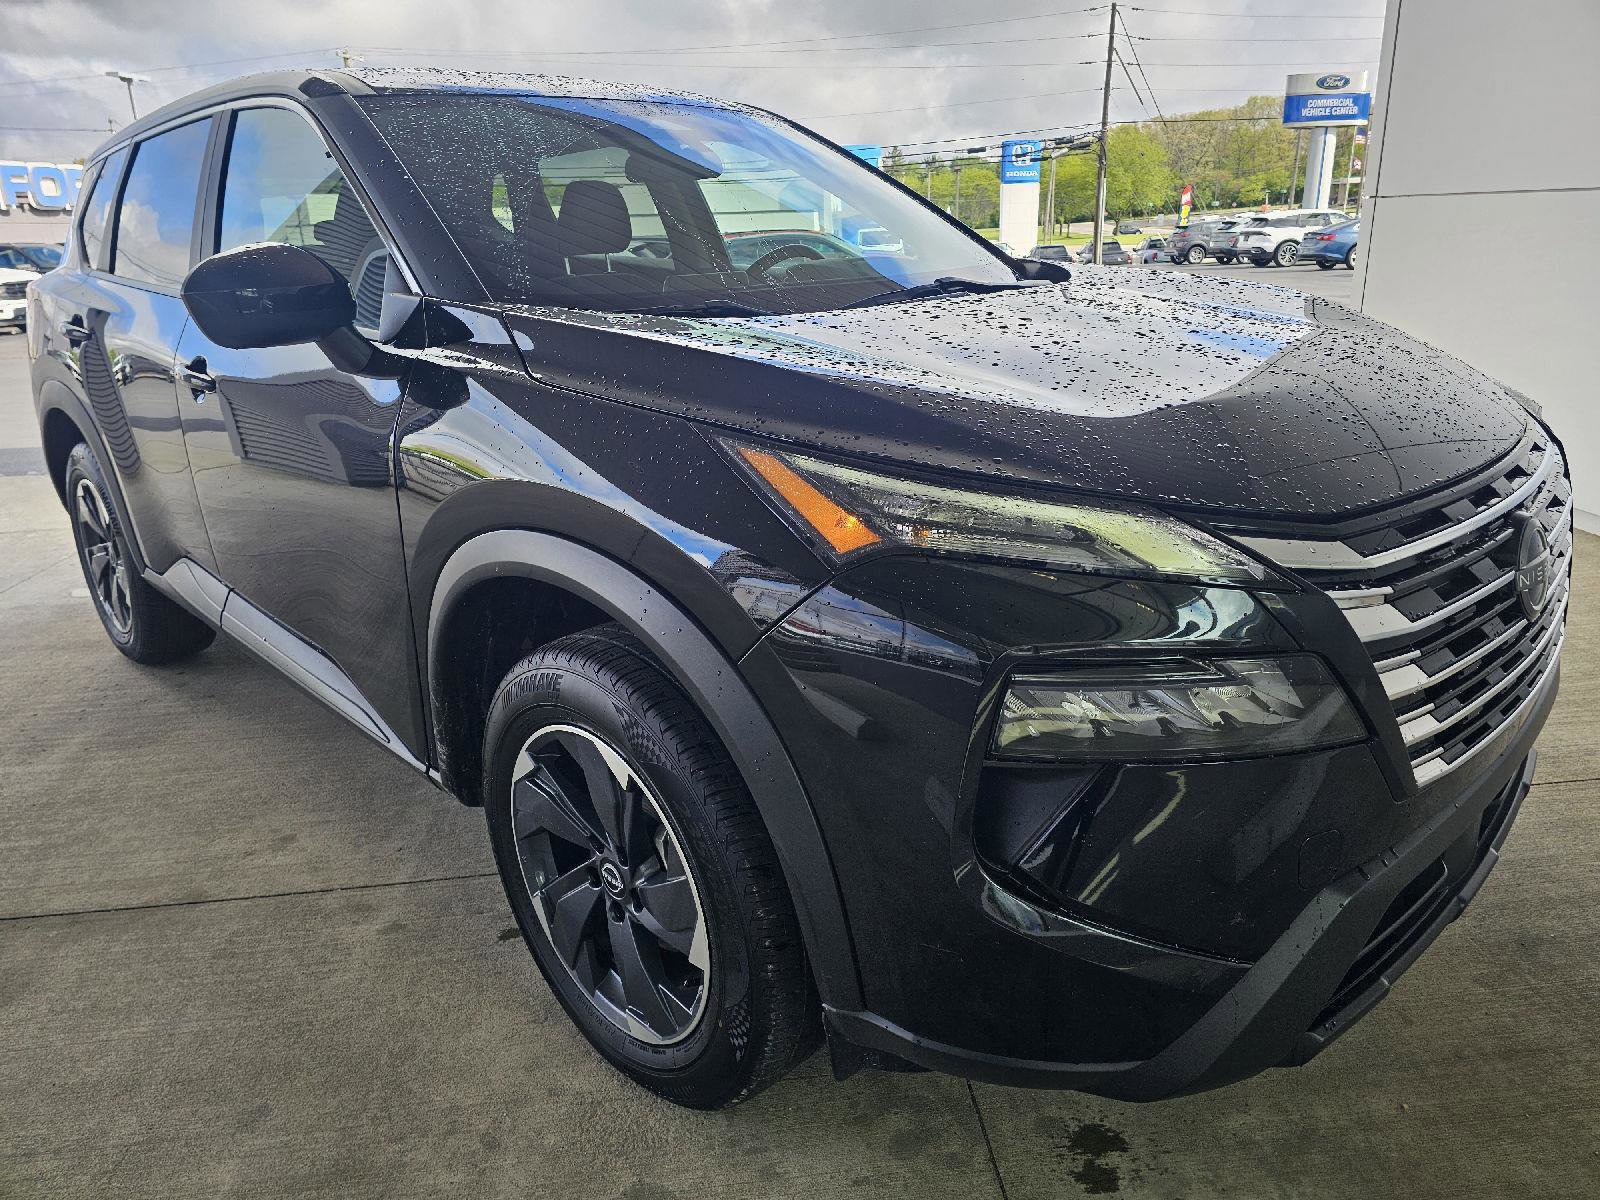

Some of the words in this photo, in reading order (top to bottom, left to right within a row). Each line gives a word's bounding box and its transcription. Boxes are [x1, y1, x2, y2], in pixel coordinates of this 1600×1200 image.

[1307, 98, 1354, 108] COMMERCIAL
[1301, 107, 1331, 117] VEHICLE
[1332, 106, 1359, 116] CENTER
